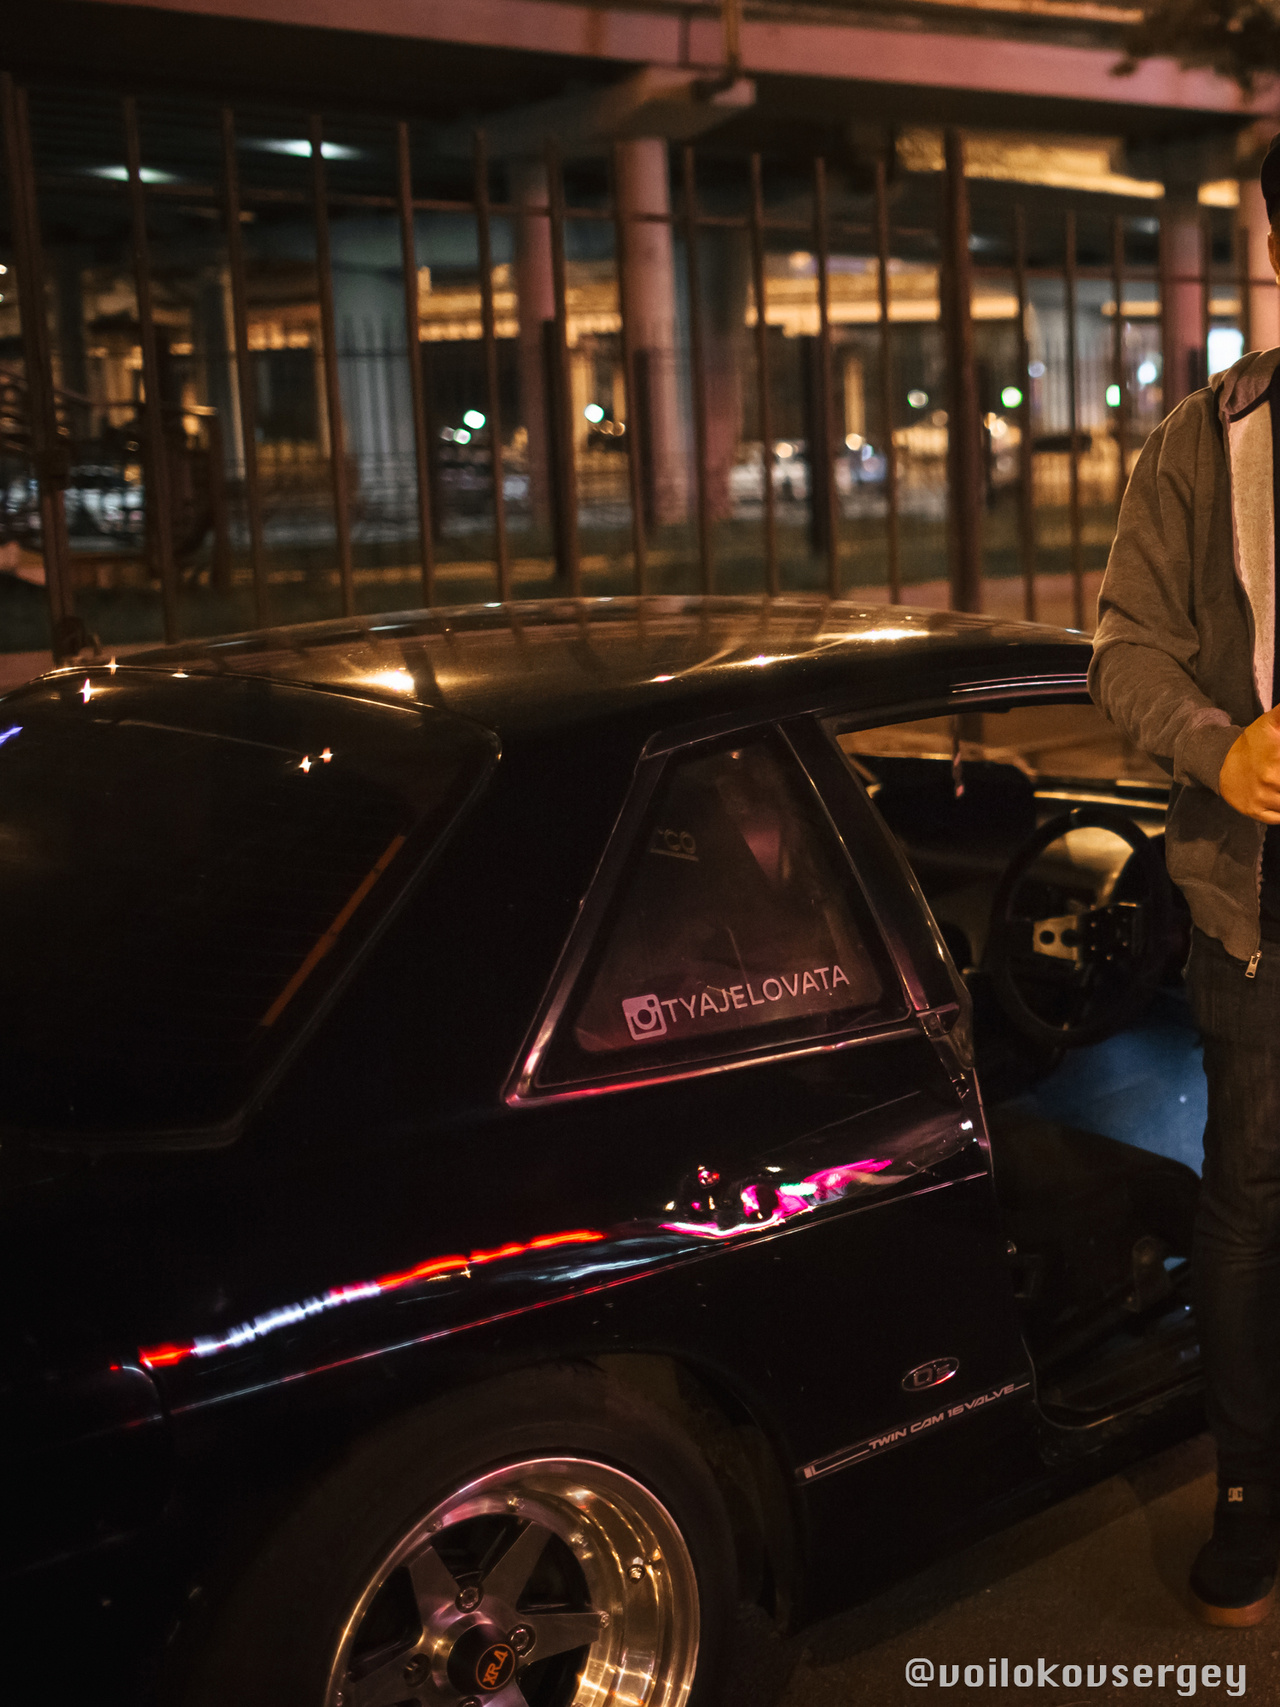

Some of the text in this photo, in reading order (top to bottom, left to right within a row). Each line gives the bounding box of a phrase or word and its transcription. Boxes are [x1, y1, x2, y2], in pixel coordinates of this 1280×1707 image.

[660, 965, 850, 1023] TYAJELOVATA
[868, 1428, 907, 1450] TWIN
[910, 1413, 944, 1433] CAM
